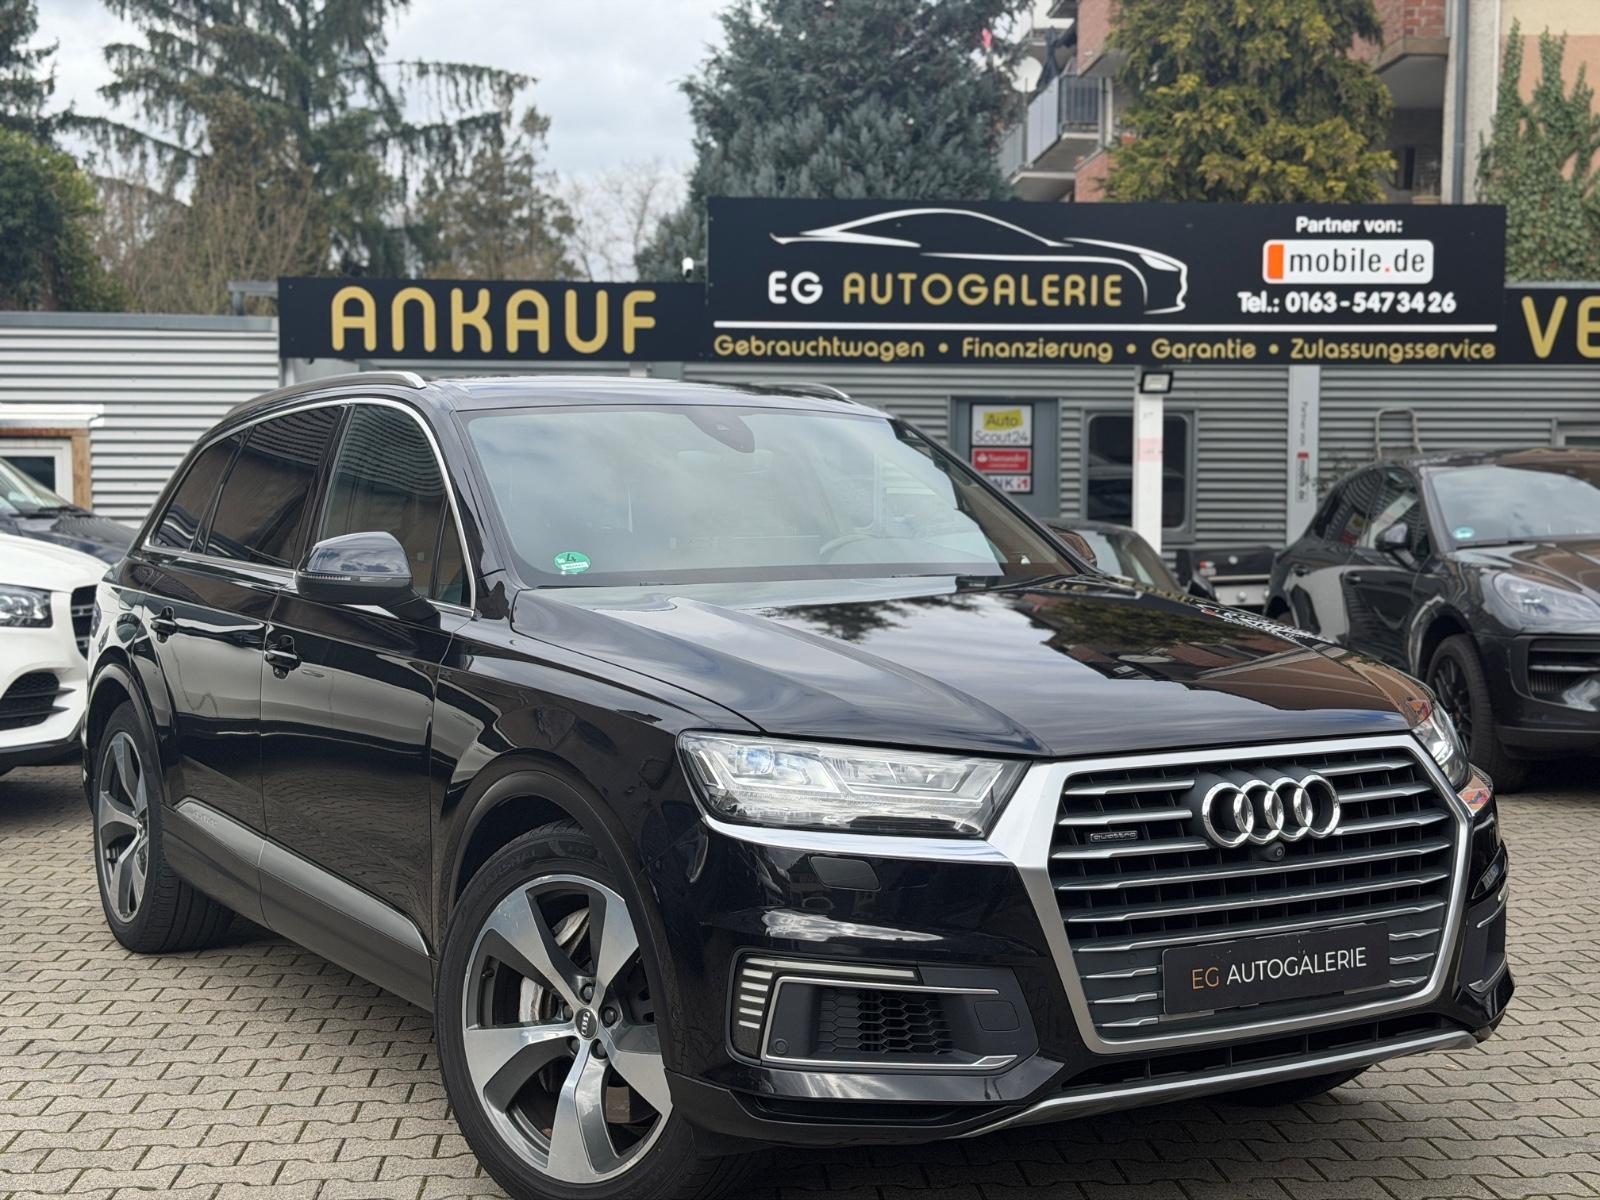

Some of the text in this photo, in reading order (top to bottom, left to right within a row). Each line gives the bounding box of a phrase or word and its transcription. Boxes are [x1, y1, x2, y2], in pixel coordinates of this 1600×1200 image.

[1295, 216, 1403, 233] Partner von:
[1289, 247, 1425, 272] mobile.de
[768, 271, 1122, 306] EG AUTOGALERIE
[1237, 290, 1280, 313] Tel.:
[331, 286, 656, 354] ANKAUF
[713, 335, 1496, 363] Gebrauchtwagen Finanzierung Garantie Zulassungsservice
[986, 413, 1018, 426] Auto
[975, 430, 1028, 443] Scout24
[1192, 947, 1367, 990] EG AUTOGALERIE
